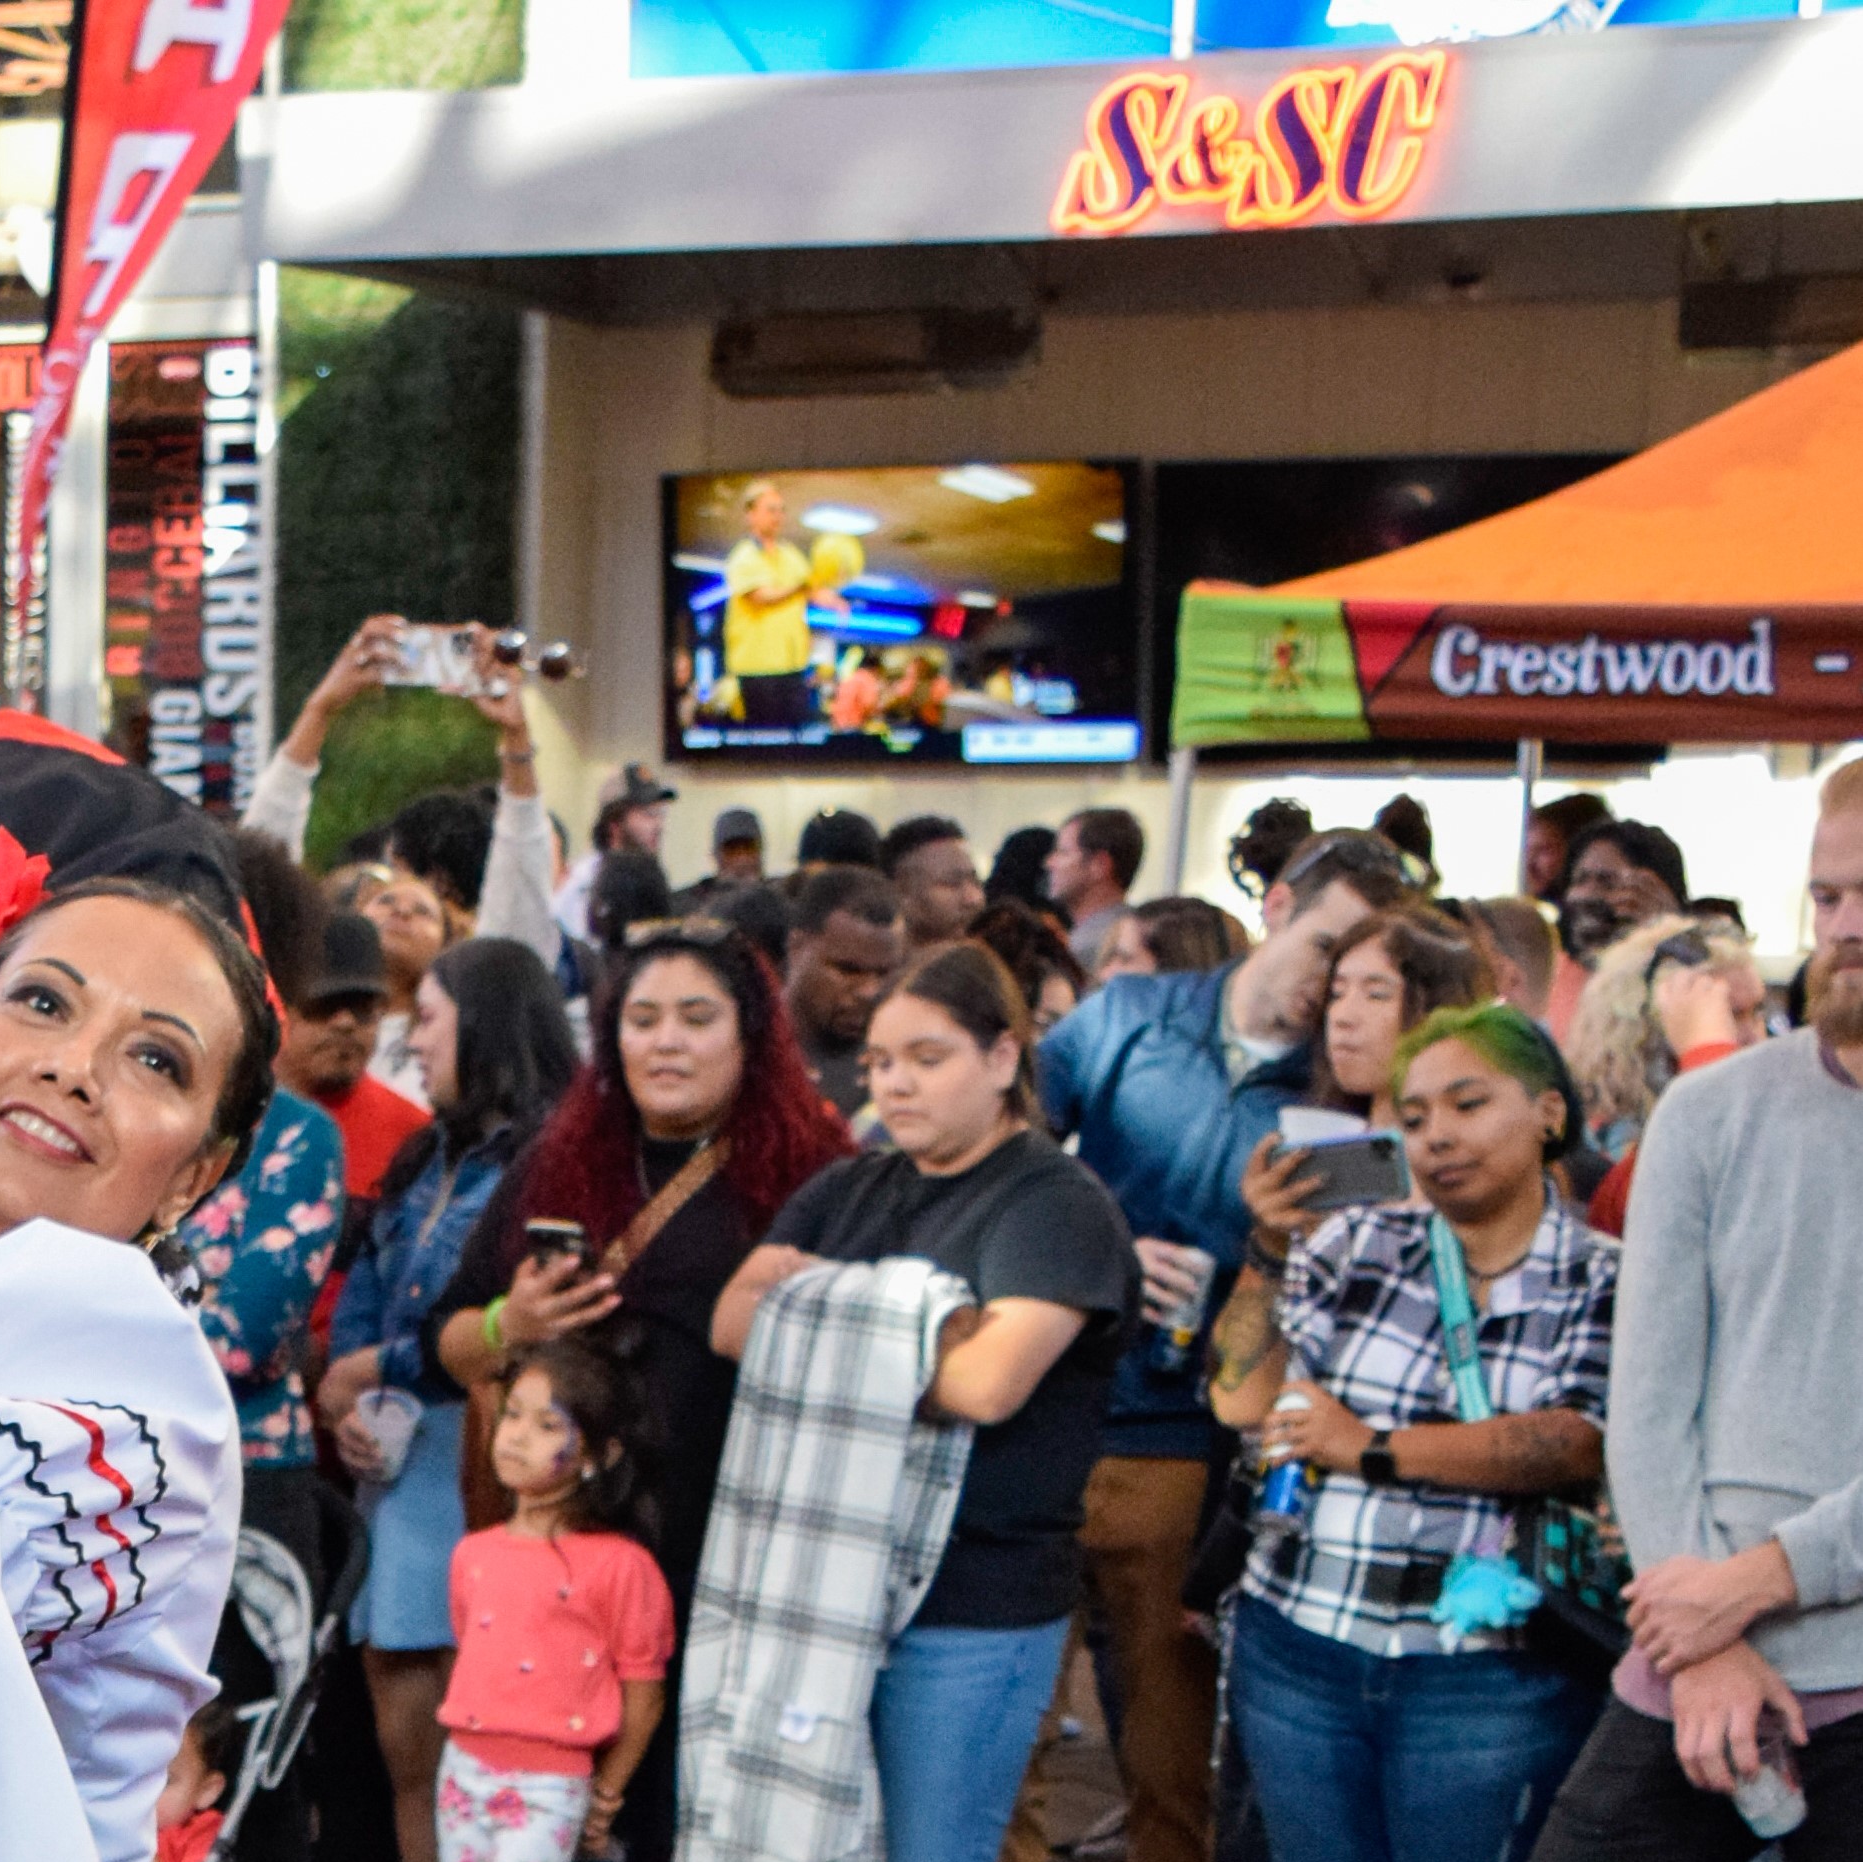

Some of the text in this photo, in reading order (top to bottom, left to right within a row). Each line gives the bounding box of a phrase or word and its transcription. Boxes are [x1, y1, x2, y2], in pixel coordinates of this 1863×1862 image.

[1049, 50, 1448, 232] S&SC
[204, 346, 262, 718] BILLIARDS
[1430, 616, 1774, 697] Crestwood
